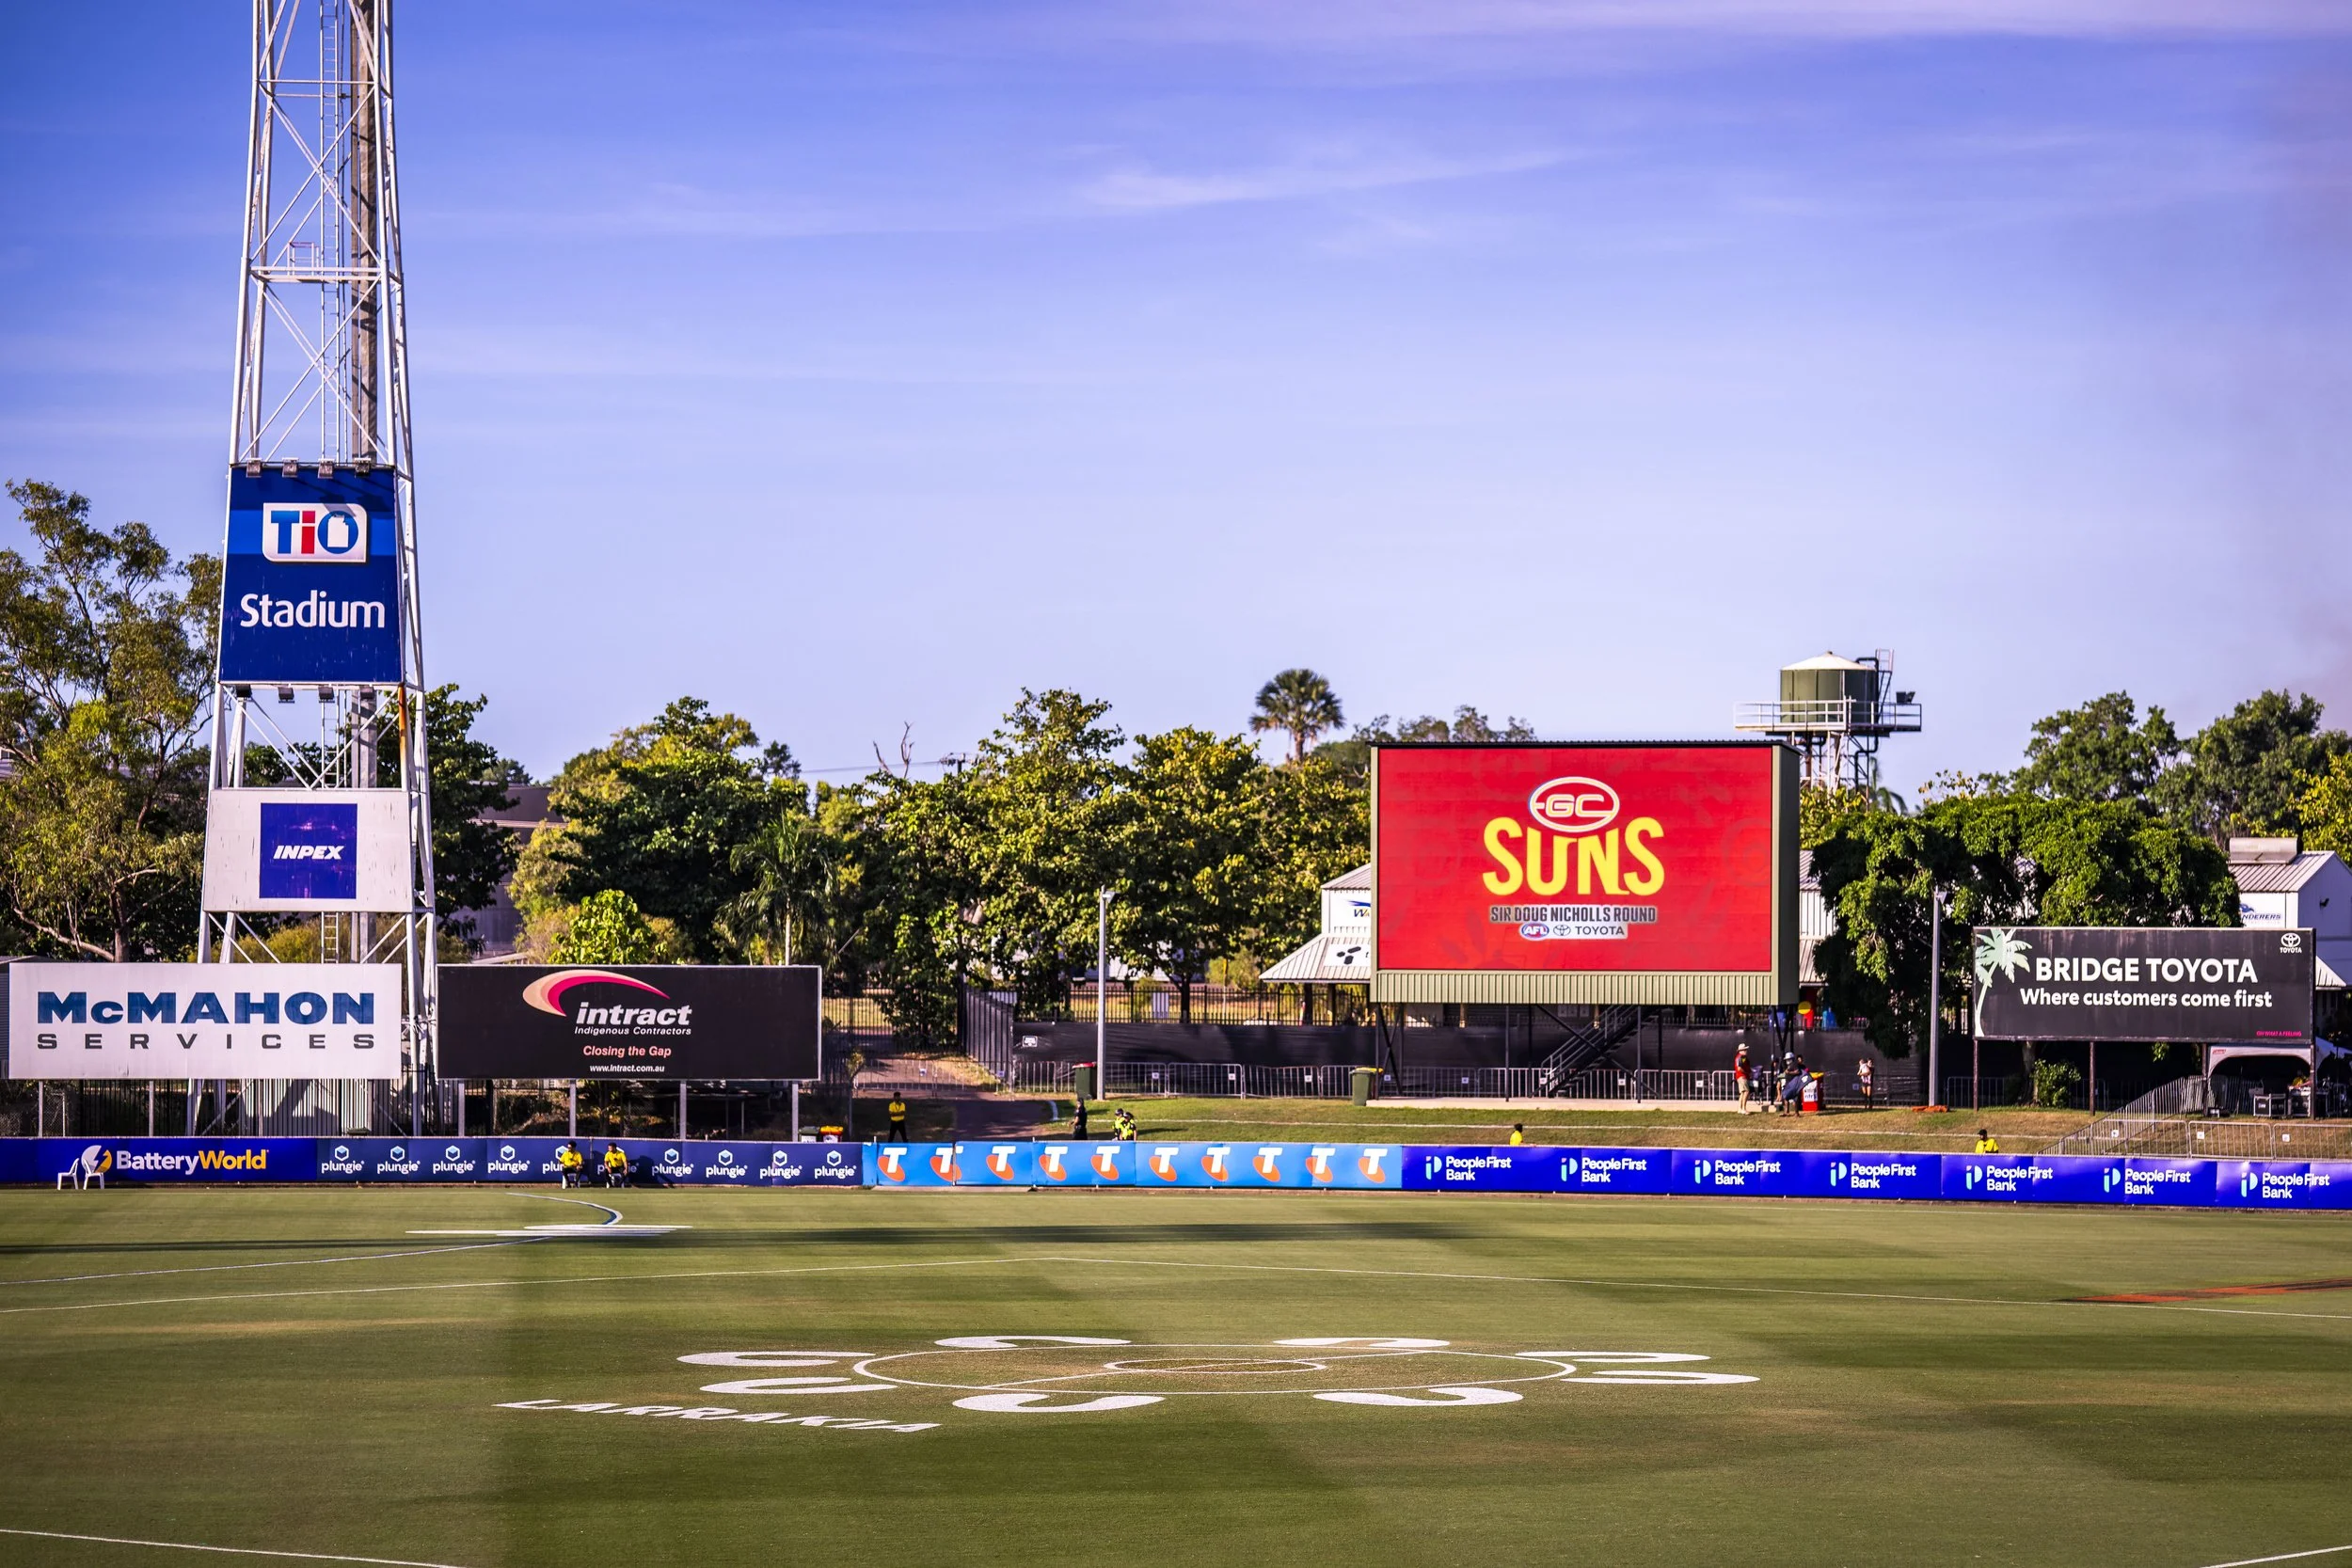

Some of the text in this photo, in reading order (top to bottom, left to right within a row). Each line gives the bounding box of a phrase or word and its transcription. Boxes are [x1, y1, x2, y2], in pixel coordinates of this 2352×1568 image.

[240, 590, 385, 627] Stadium
[274, 845, 344, 860] INPEX
[1483, 816, 1664, 896] SUNS
[1491, 907, 1657, 922] SIR DOUG NICHOLLS ROUND
[1522, 925, 1549, 936] AFL
[1575, 926, 1625, 936] TOYOTA
[2036, 958, 2259, 983] BRIDGE TOYOTA
[2020, 988, 2272, 1007] Where customers come first
[38, 991, 374, 1024] McMAHON
[576, 1002, 692, 1025] intract
[575, 1026, 691, 1037] Indigenous Contractors
[38, 1034, 374, 1049] SERVICES
[583, 1046, 672, 1058] Closing the Gap
[117, 1149, 267, 1175] BatteryWorld
[321, 1160, 363, 1174] plungie
[377, 1161, 420, 1174] plungie
[433, 1160, 474, 1174] plungie
[487, 1160, 529, 1174] plungie
[651, 1164, 692, 1177] plungie
[706, 1164, 746, 1179] plungie
[759, 1165, 801, 1179] plungie
[814, 1165, 855, 1179] plungie
[1446, 1169, 1475, 1180] Bank
[1582, 1170, 1611, 1182] Bank
[1715, 1173, 1744, 1185] Bank
[1851, 1176, 1880, 1188] Bank
[1987, 1179, 2016, 1191] Bank
[2125, 1181, 2153, 1195] Bank
[2263, 1186, 2292, 1198] Bank
[492, 1400, 942, 1433] LARRAKIA
